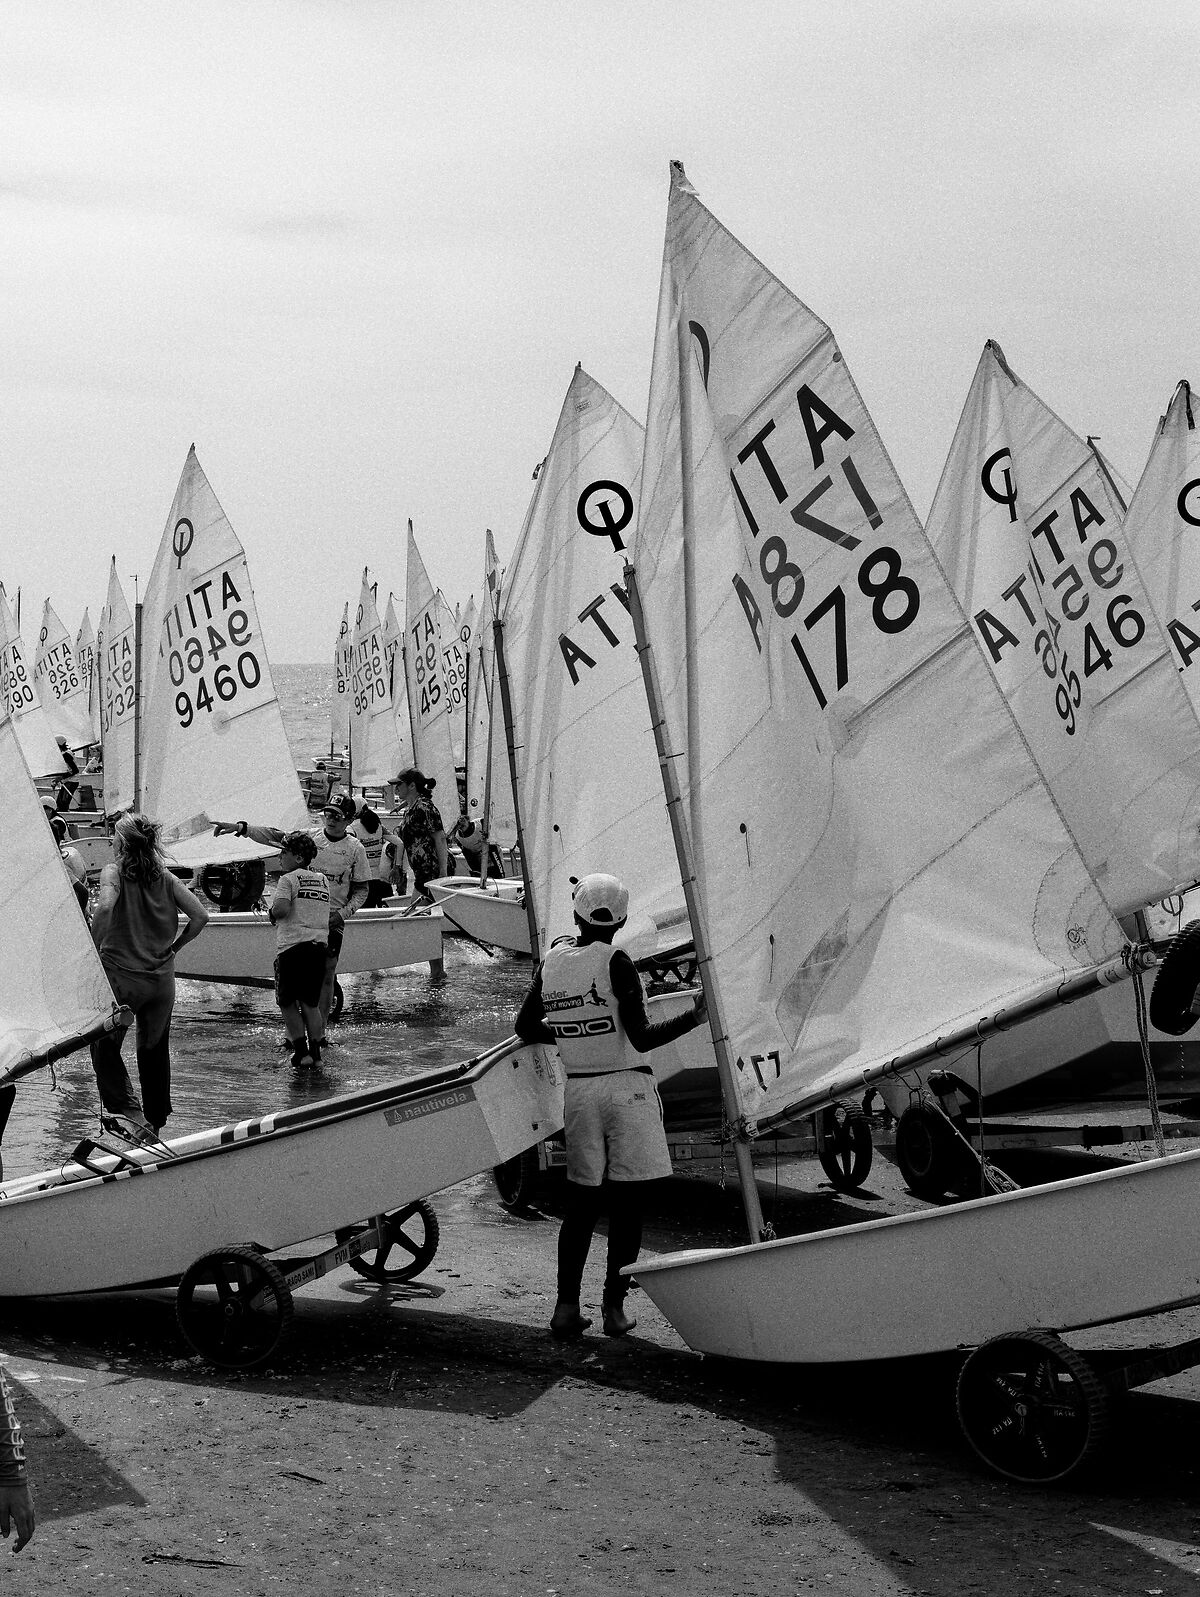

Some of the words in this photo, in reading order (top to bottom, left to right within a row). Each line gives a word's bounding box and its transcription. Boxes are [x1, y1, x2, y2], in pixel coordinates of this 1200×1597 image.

[729, 383, 857, 539] ITA
[186, 571, 242, 629] ITA
[790, 545, 921, 711] 178
[47, 642, 72, 667] ITA
[52, 672, 79, 700] 326
[175, 651, 262, 729] 9460
[354, 677, 386, 716] 9570
[404, 1091, 467, 1121] nautivela
